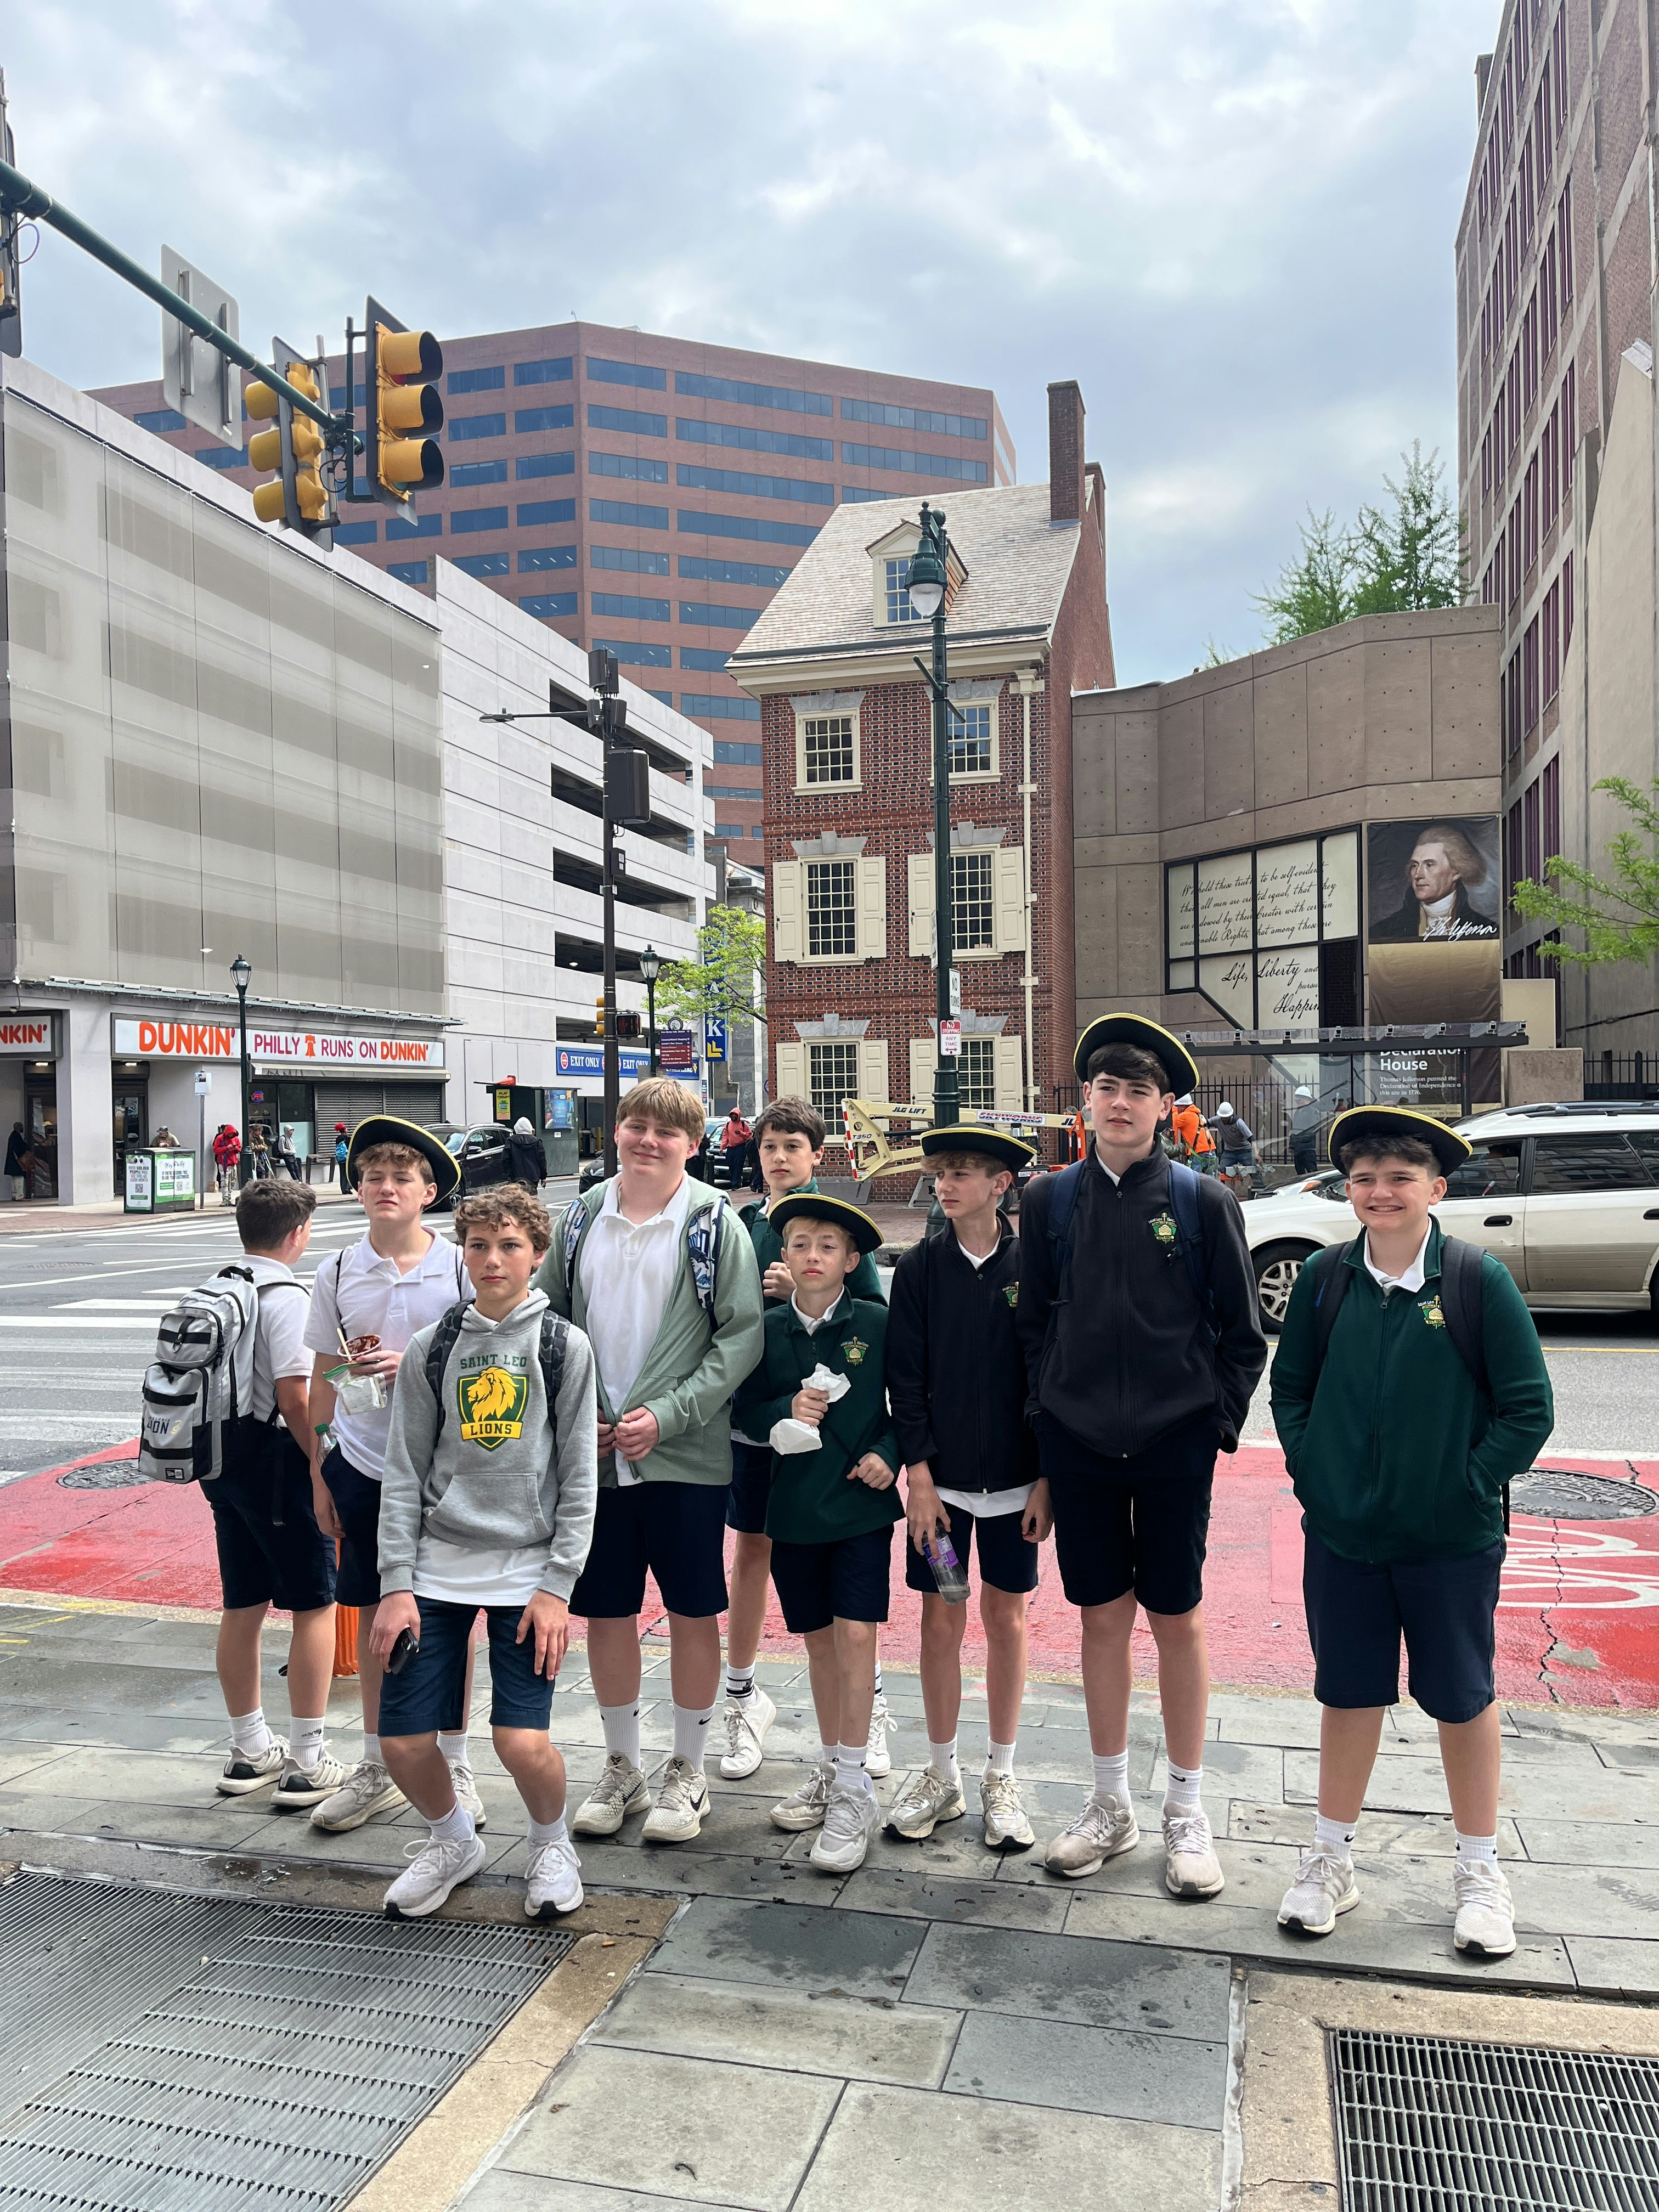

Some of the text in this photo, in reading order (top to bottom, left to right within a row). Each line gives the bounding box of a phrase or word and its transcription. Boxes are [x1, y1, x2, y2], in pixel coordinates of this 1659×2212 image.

[1198, 880, 1212, 894] hold
[1215, 879, 1233, 890] these
[1235, 874, 1252, 887] trut
[1261, 872, 1269, 883] to
[1270, 868, 1278, 881] be
[1201, 898, 1211, 910] all
[1243, 891, 1266, 902] creted
[1268, 884, 1290, 904] equal,
[1294, 882, 1317, 895] that
[1322, 878, 1336, 896] hey
[1192, 916, 1221, 929] edowed
[1223, 911, 1233, 929] by
[1285, 900, 1305, 915] with
[1307, 897, 1333, 912] cerin
[1257, 924, 1271, 936] hat
[1271, 926, 1295, 940] among
[1298, 917, 1318, 930] these
[1222, 962, 1248, 989] Life,
[1257, 957, 1301, 986] Liberty
[952, 977, 957, 991] NO
[139, 1021, 235, 1056] DUNKIN'
[254, 1034, 428, 1062] PHILLY RUNS ON DUNKIN'
[570, 1056, 600, 1068] EXIT ONLY
[623, 1059, 635, 1069] EXIT
[1380, 1059, 1428, 1071] House
[978, 1111, 1043, 1124] SKYWORKS
[1061, 1118, 1075, 1126] JL
[460, 1354, 527, 1369] SAINT LEO
[470, 1423, 512, 1436] LIONS
